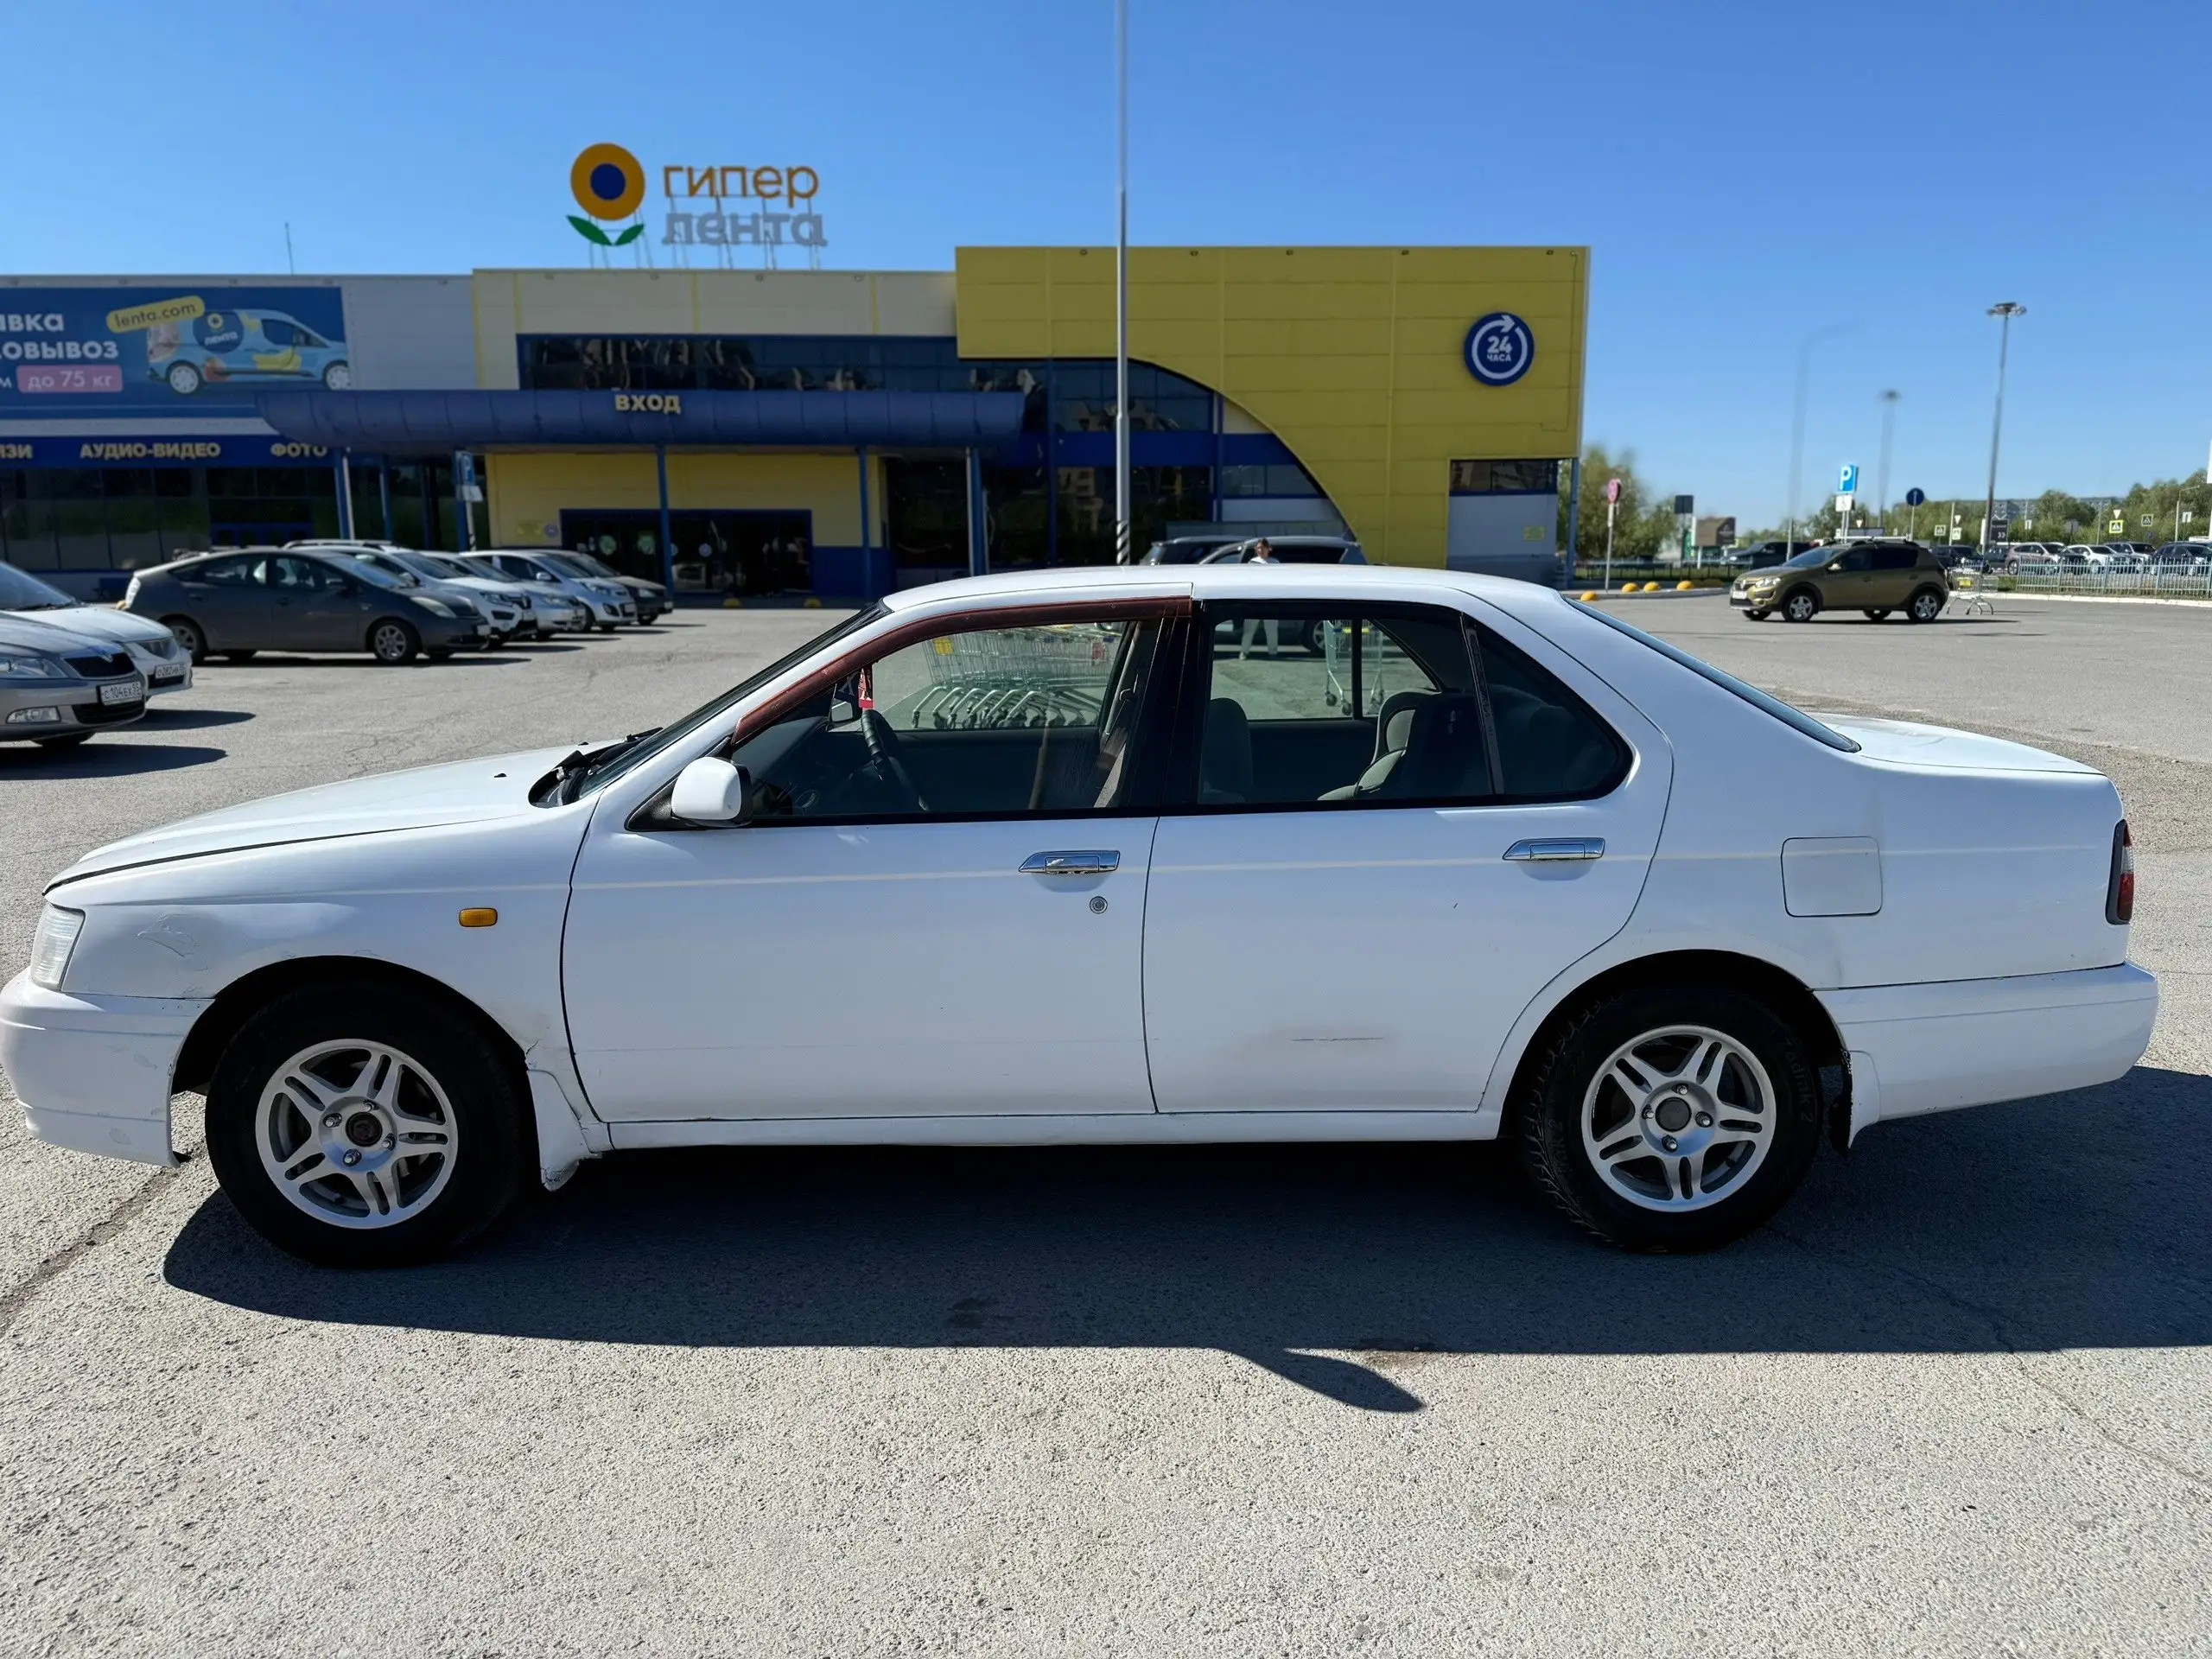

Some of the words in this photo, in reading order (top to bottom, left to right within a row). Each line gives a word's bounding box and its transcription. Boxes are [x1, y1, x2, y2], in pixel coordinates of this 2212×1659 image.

[663, 165, 819, 208] гипер
[661, 213, 828, 247] лента
[114, 303, 197, 328] lenta.com
[0, 340, 119, 360] овывоз
[1487, 335, 1513, 353] 24
[28, 375, 54, 391] до
[60, 370, 85, 388] 75
[92, 375, 112, 388] кг
[79, 442, 221, 460] АУДИО-ВИДЕО
[270, 442, 327, 458] ФОТО
